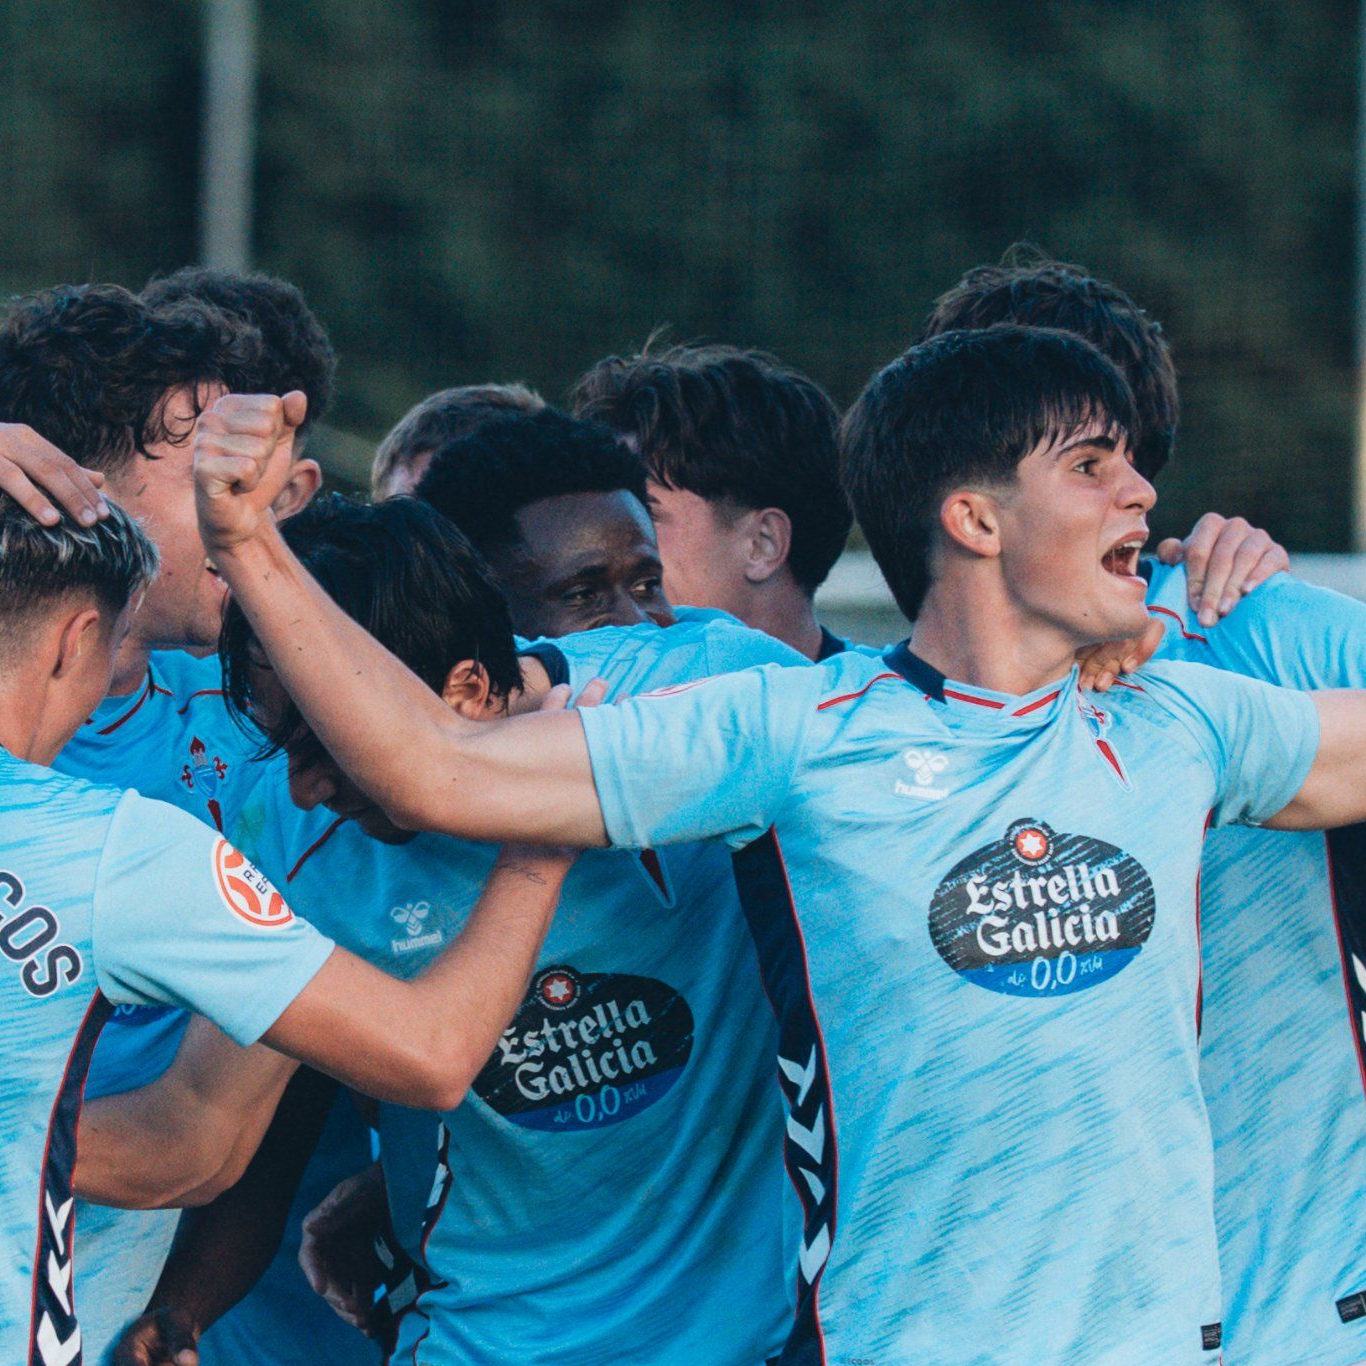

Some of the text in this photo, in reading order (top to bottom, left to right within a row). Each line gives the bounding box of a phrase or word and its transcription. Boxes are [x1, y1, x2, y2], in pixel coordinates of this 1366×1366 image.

[965, 863, 1122, 916] Estrella
[976, 904, 1121, 957] Galicia
[1031, 950, 1078, 990] 0,0
[498, 999, 653, 1066] Estrella
[515, 1038, 658, 1101] Galicia
[575, 1084, 621, 1123] 0,0
